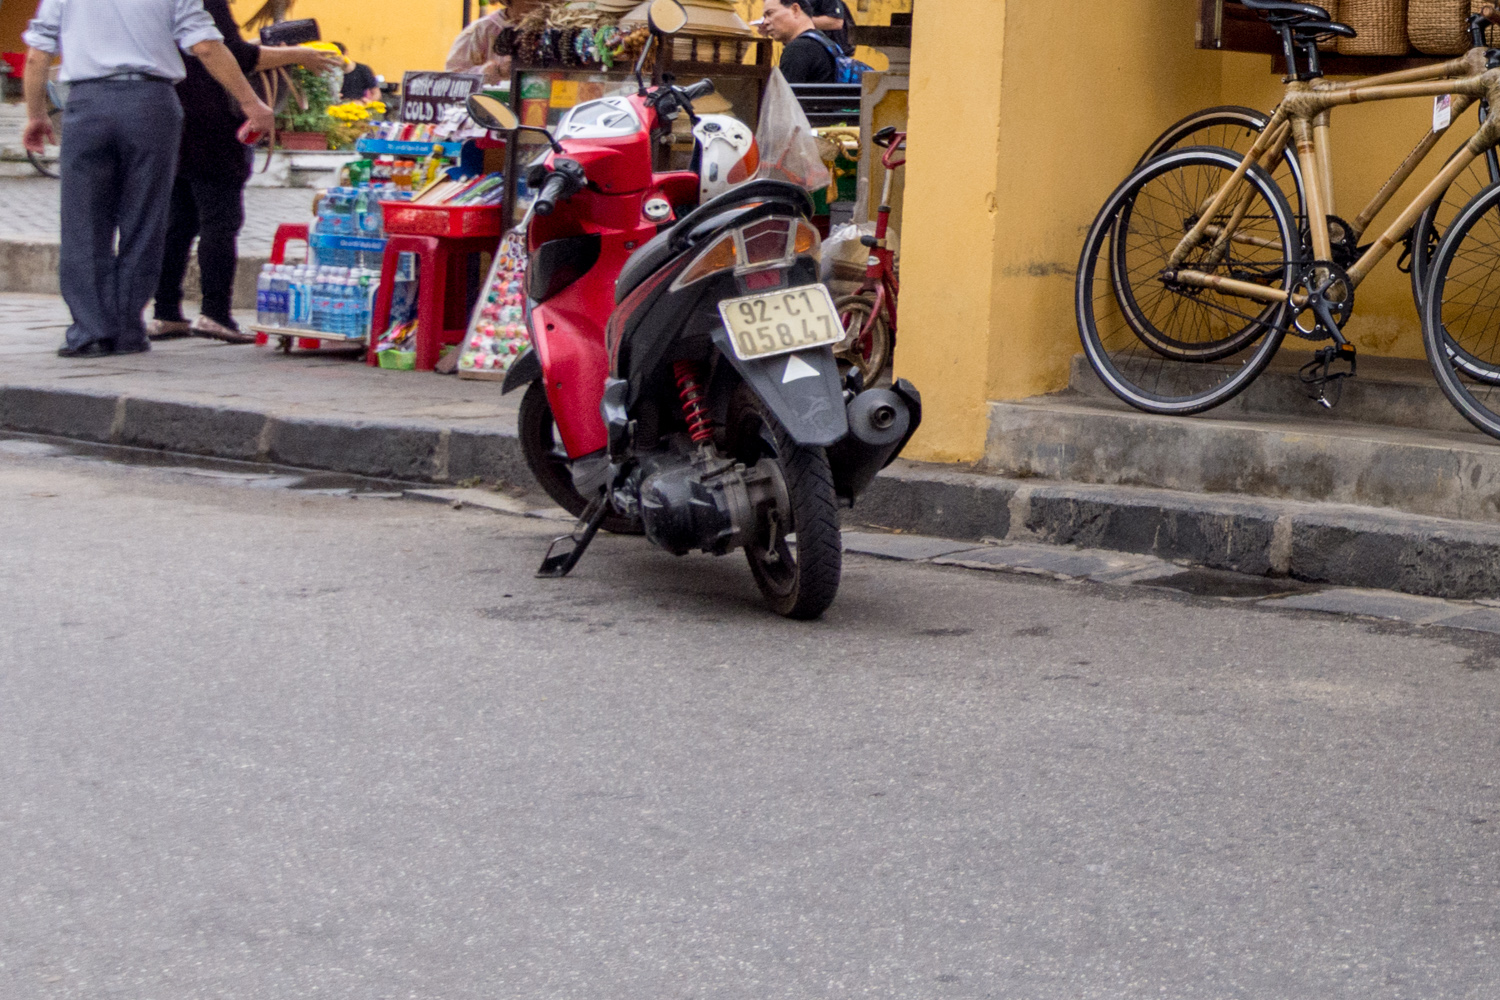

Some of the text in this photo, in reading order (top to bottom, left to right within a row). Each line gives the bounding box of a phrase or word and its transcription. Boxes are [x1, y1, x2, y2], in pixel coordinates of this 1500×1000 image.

[405, 101, 434, 121] COLD
[739, 292, 814, 325] 92-C1
[738, 315, 832, 353] 058.47
